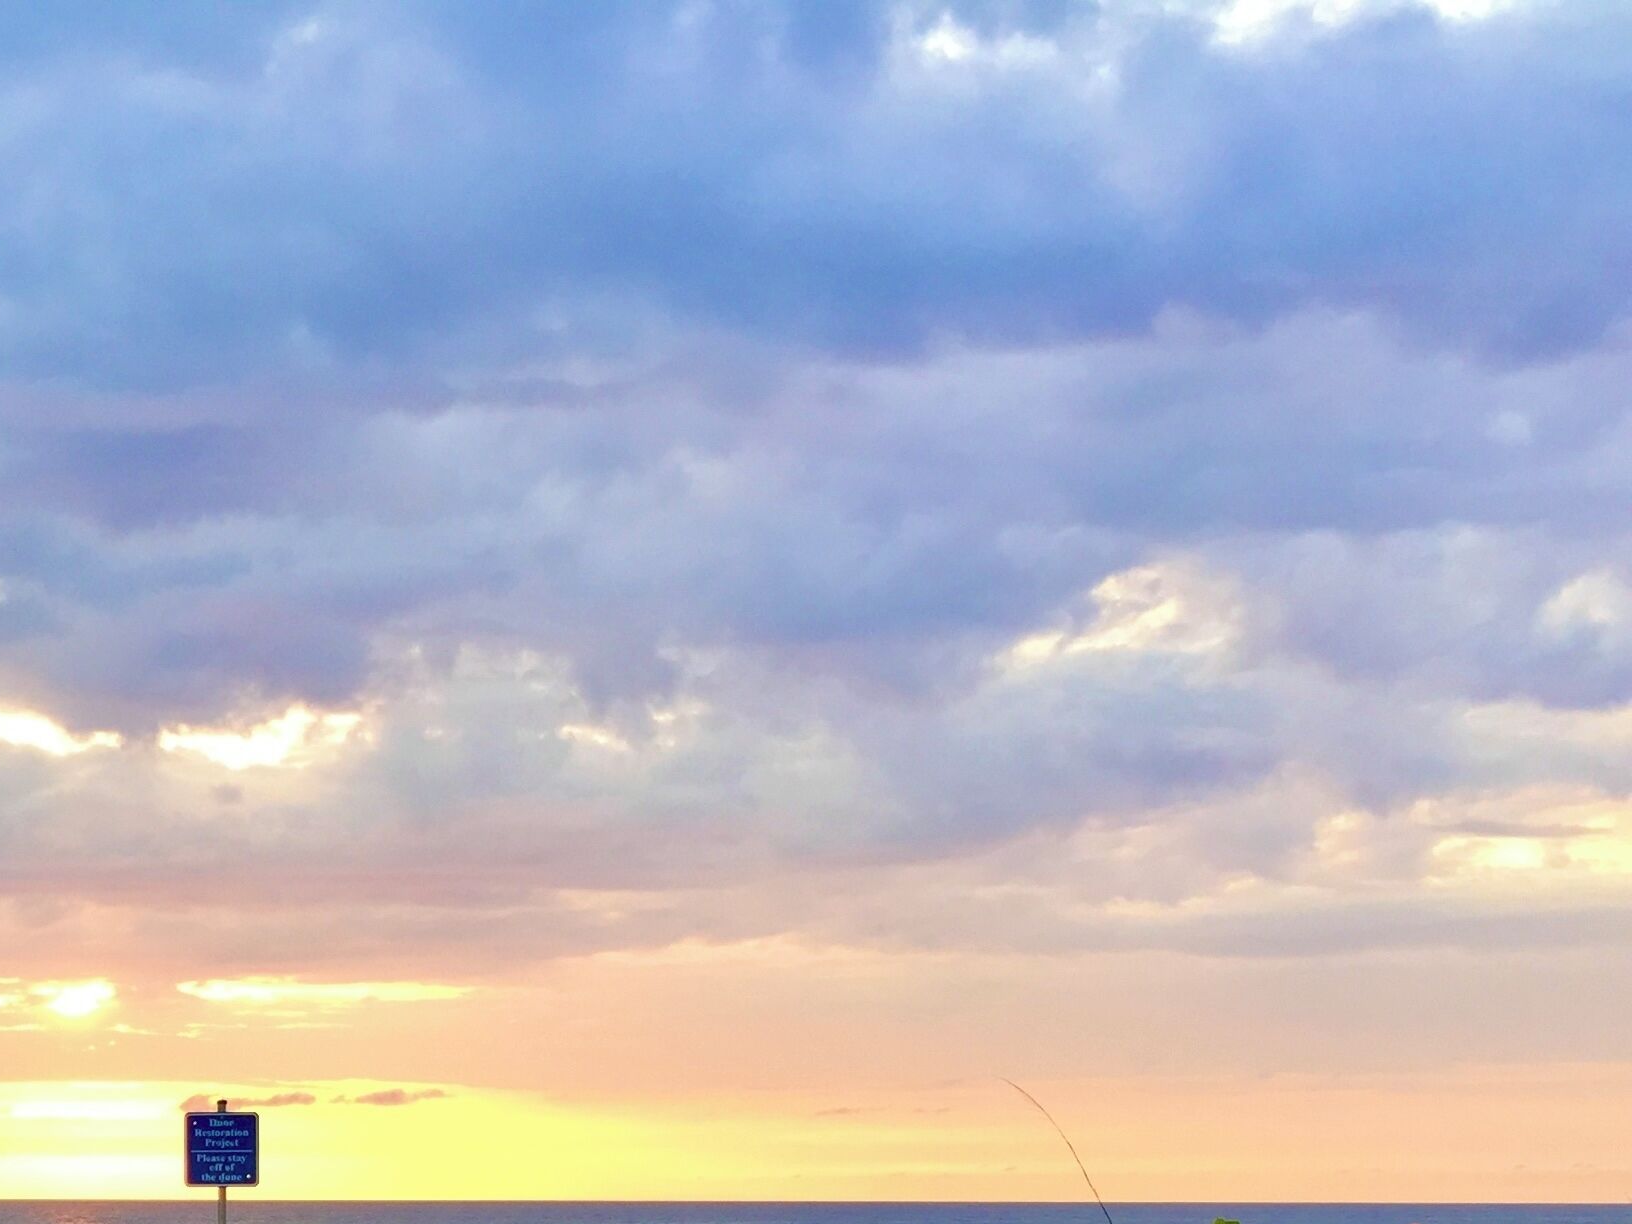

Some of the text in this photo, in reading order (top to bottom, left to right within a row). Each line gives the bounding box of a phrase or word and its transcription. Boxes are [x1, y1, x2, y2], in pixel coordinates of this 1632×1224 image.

[194, 1128, 249, 1137] Restoration
[205, 1138, 239, 1148] Project
[196, 1154, 247, 1164] Please stay
[201, 1173, 217, 1181] the
